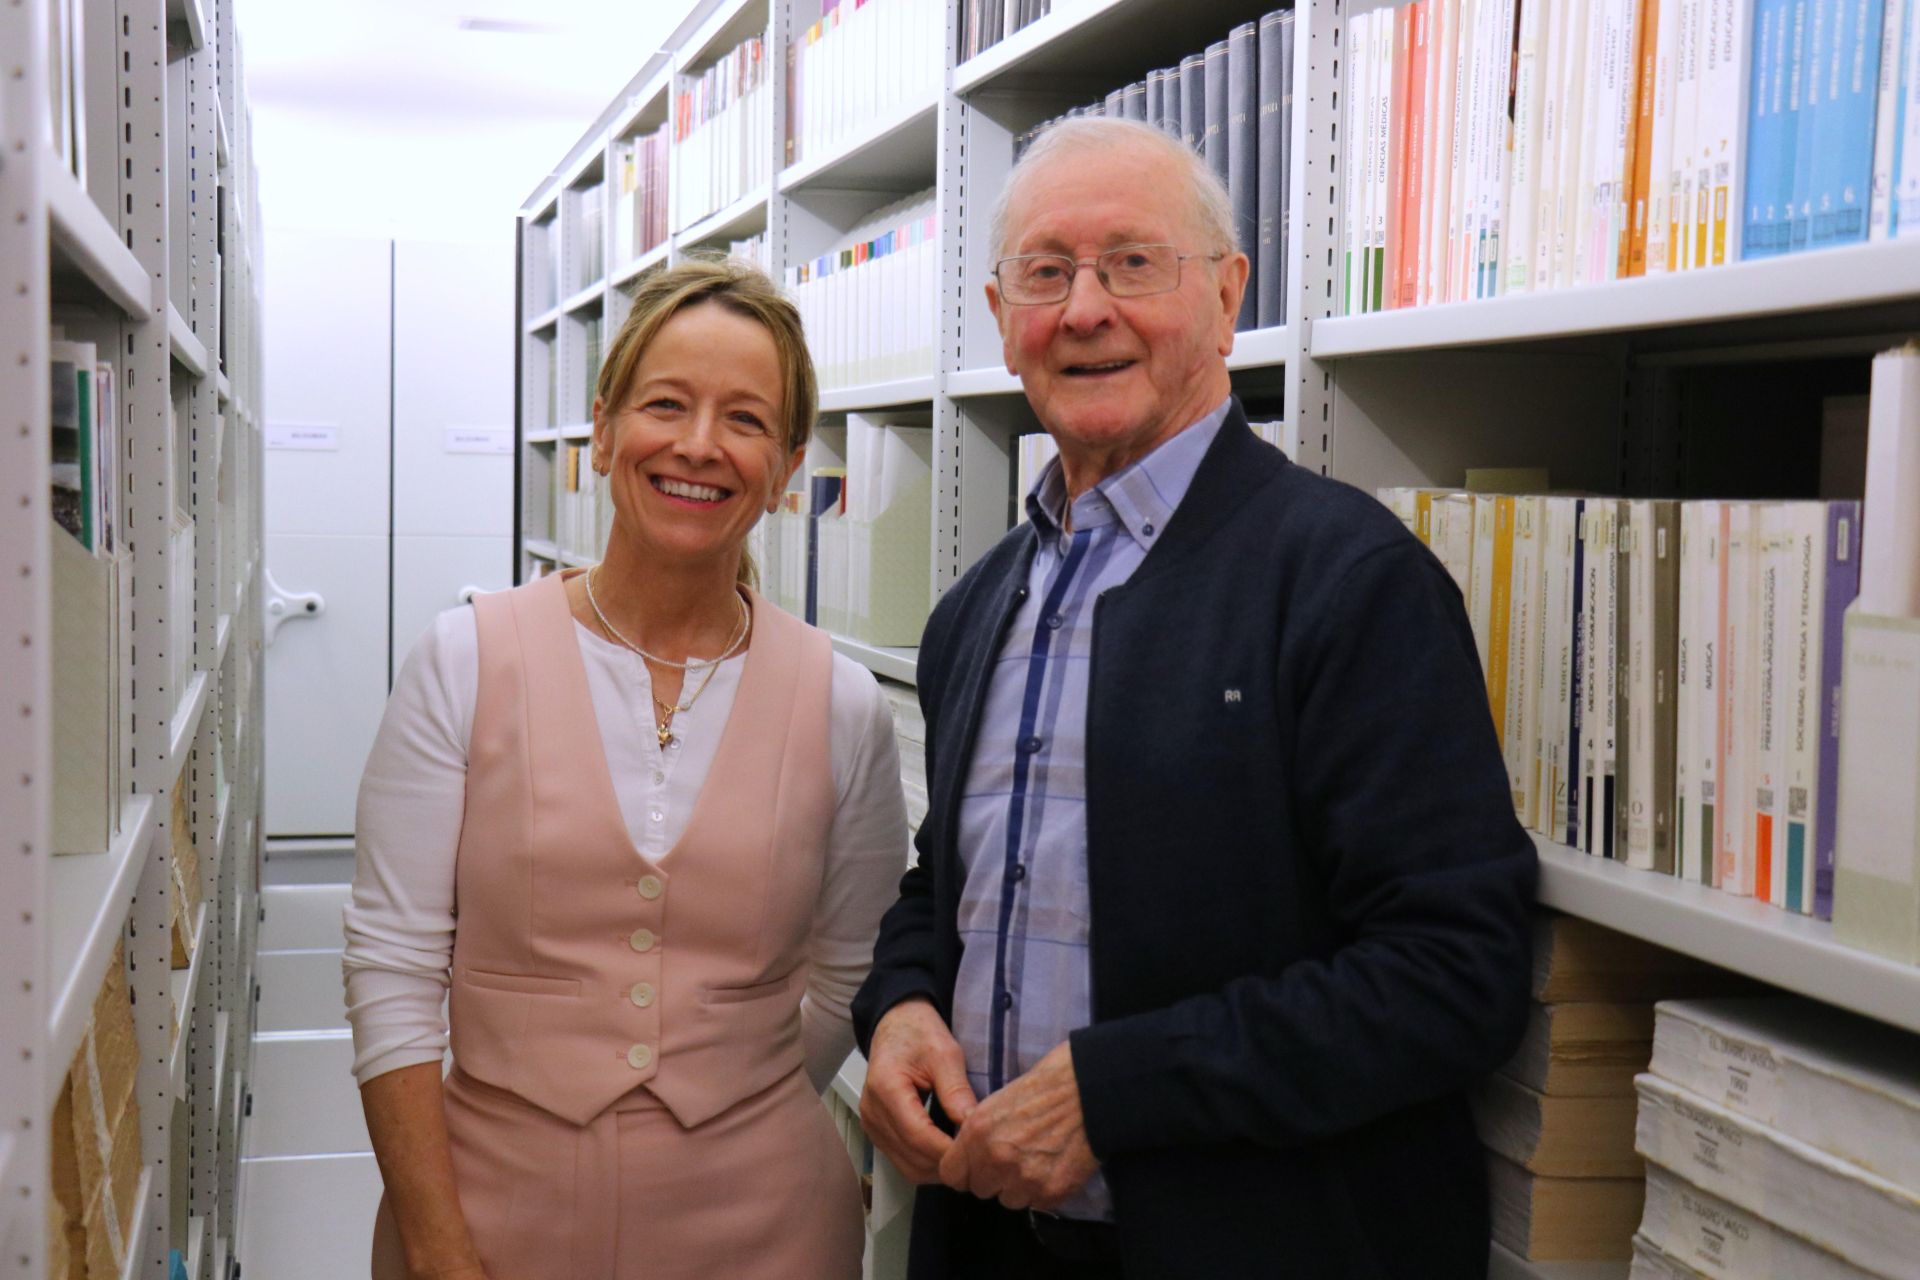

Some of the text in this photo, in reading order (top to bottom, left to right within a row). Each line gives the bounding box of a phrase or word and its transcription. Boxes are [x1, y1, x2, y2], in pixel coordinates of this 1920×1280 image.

[1707, 0, 1719, 70] EDUCACIO
[1455, 56, 1463, 118] NATURALES
[1473, 48, 1481, 111] NATURALES
[1378, 141, 1387, 184] CIENCIAS
[1559, 645, 1568, 704] MEDICINA
[1589, 656, 1595, 669] DE
[1798, 631, 1807, 682] CIENCIA
